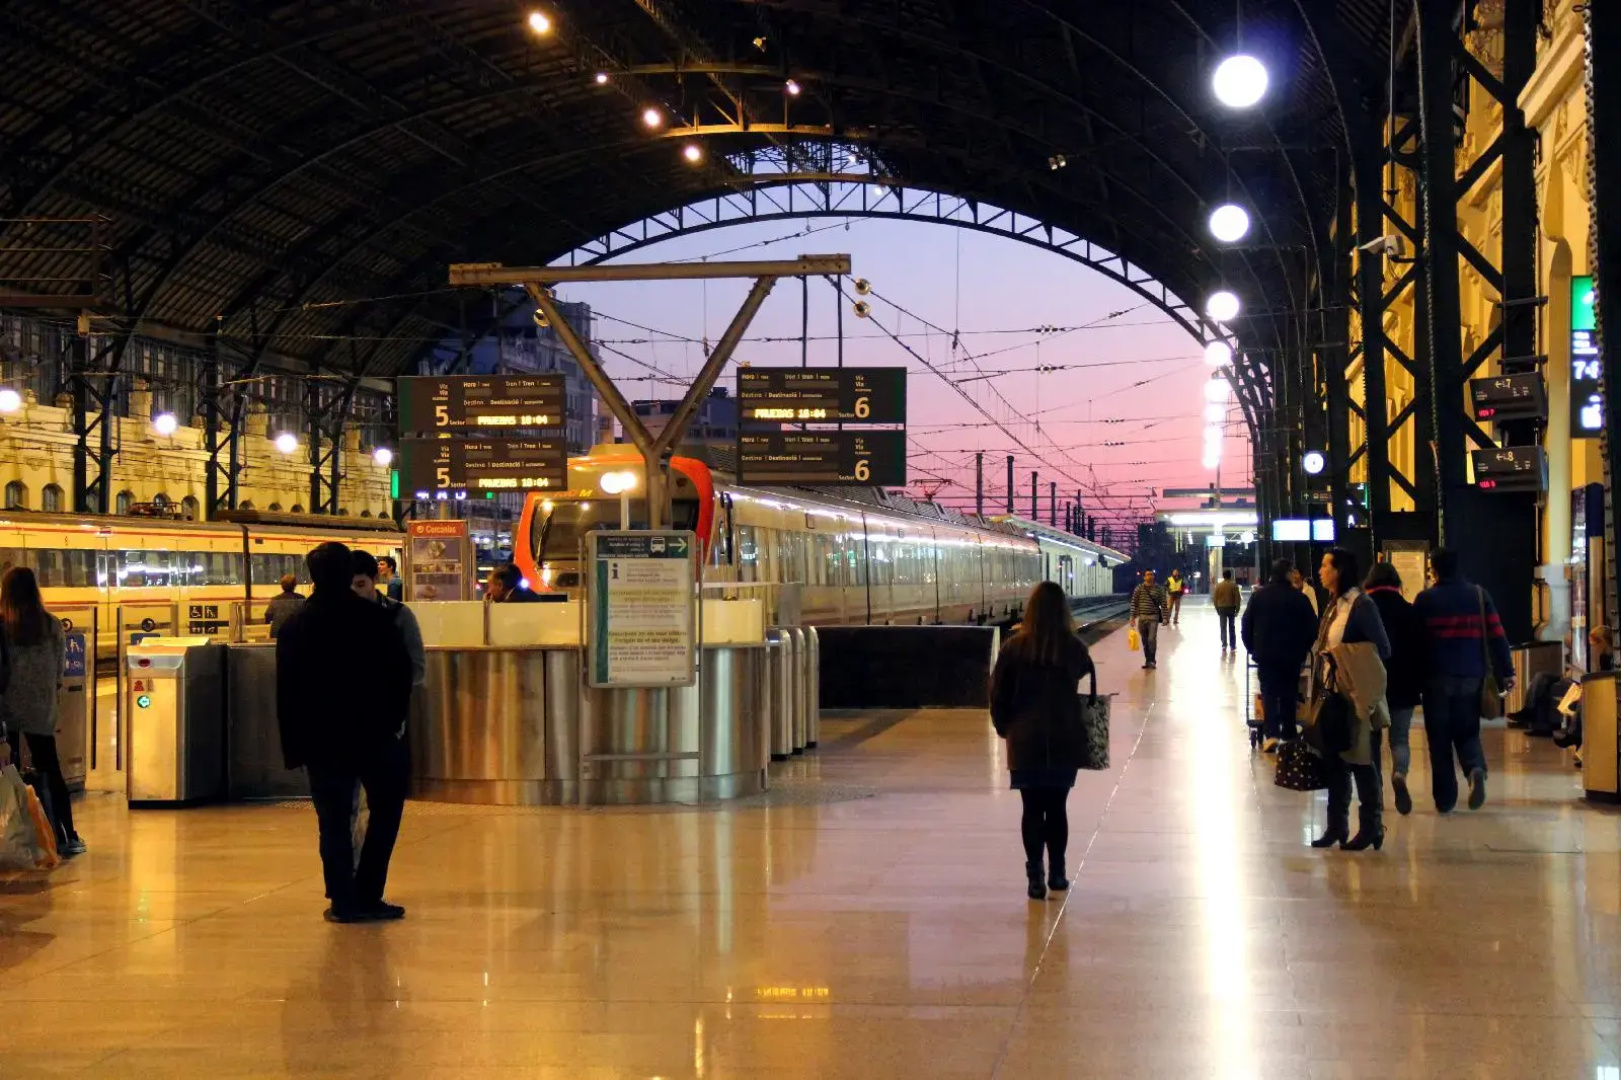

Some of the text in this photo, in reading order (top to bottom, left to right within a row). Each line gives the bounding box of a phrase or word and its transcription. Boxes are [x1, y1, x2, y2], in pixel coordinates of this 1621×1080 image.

[436, 406, 448, 426] 5
[854, 396, 870, 418] 6
[1508, 451, 1514, 461] 8
[437, 468, 450, 488] 5
[854, 460, 870, 480] 6
